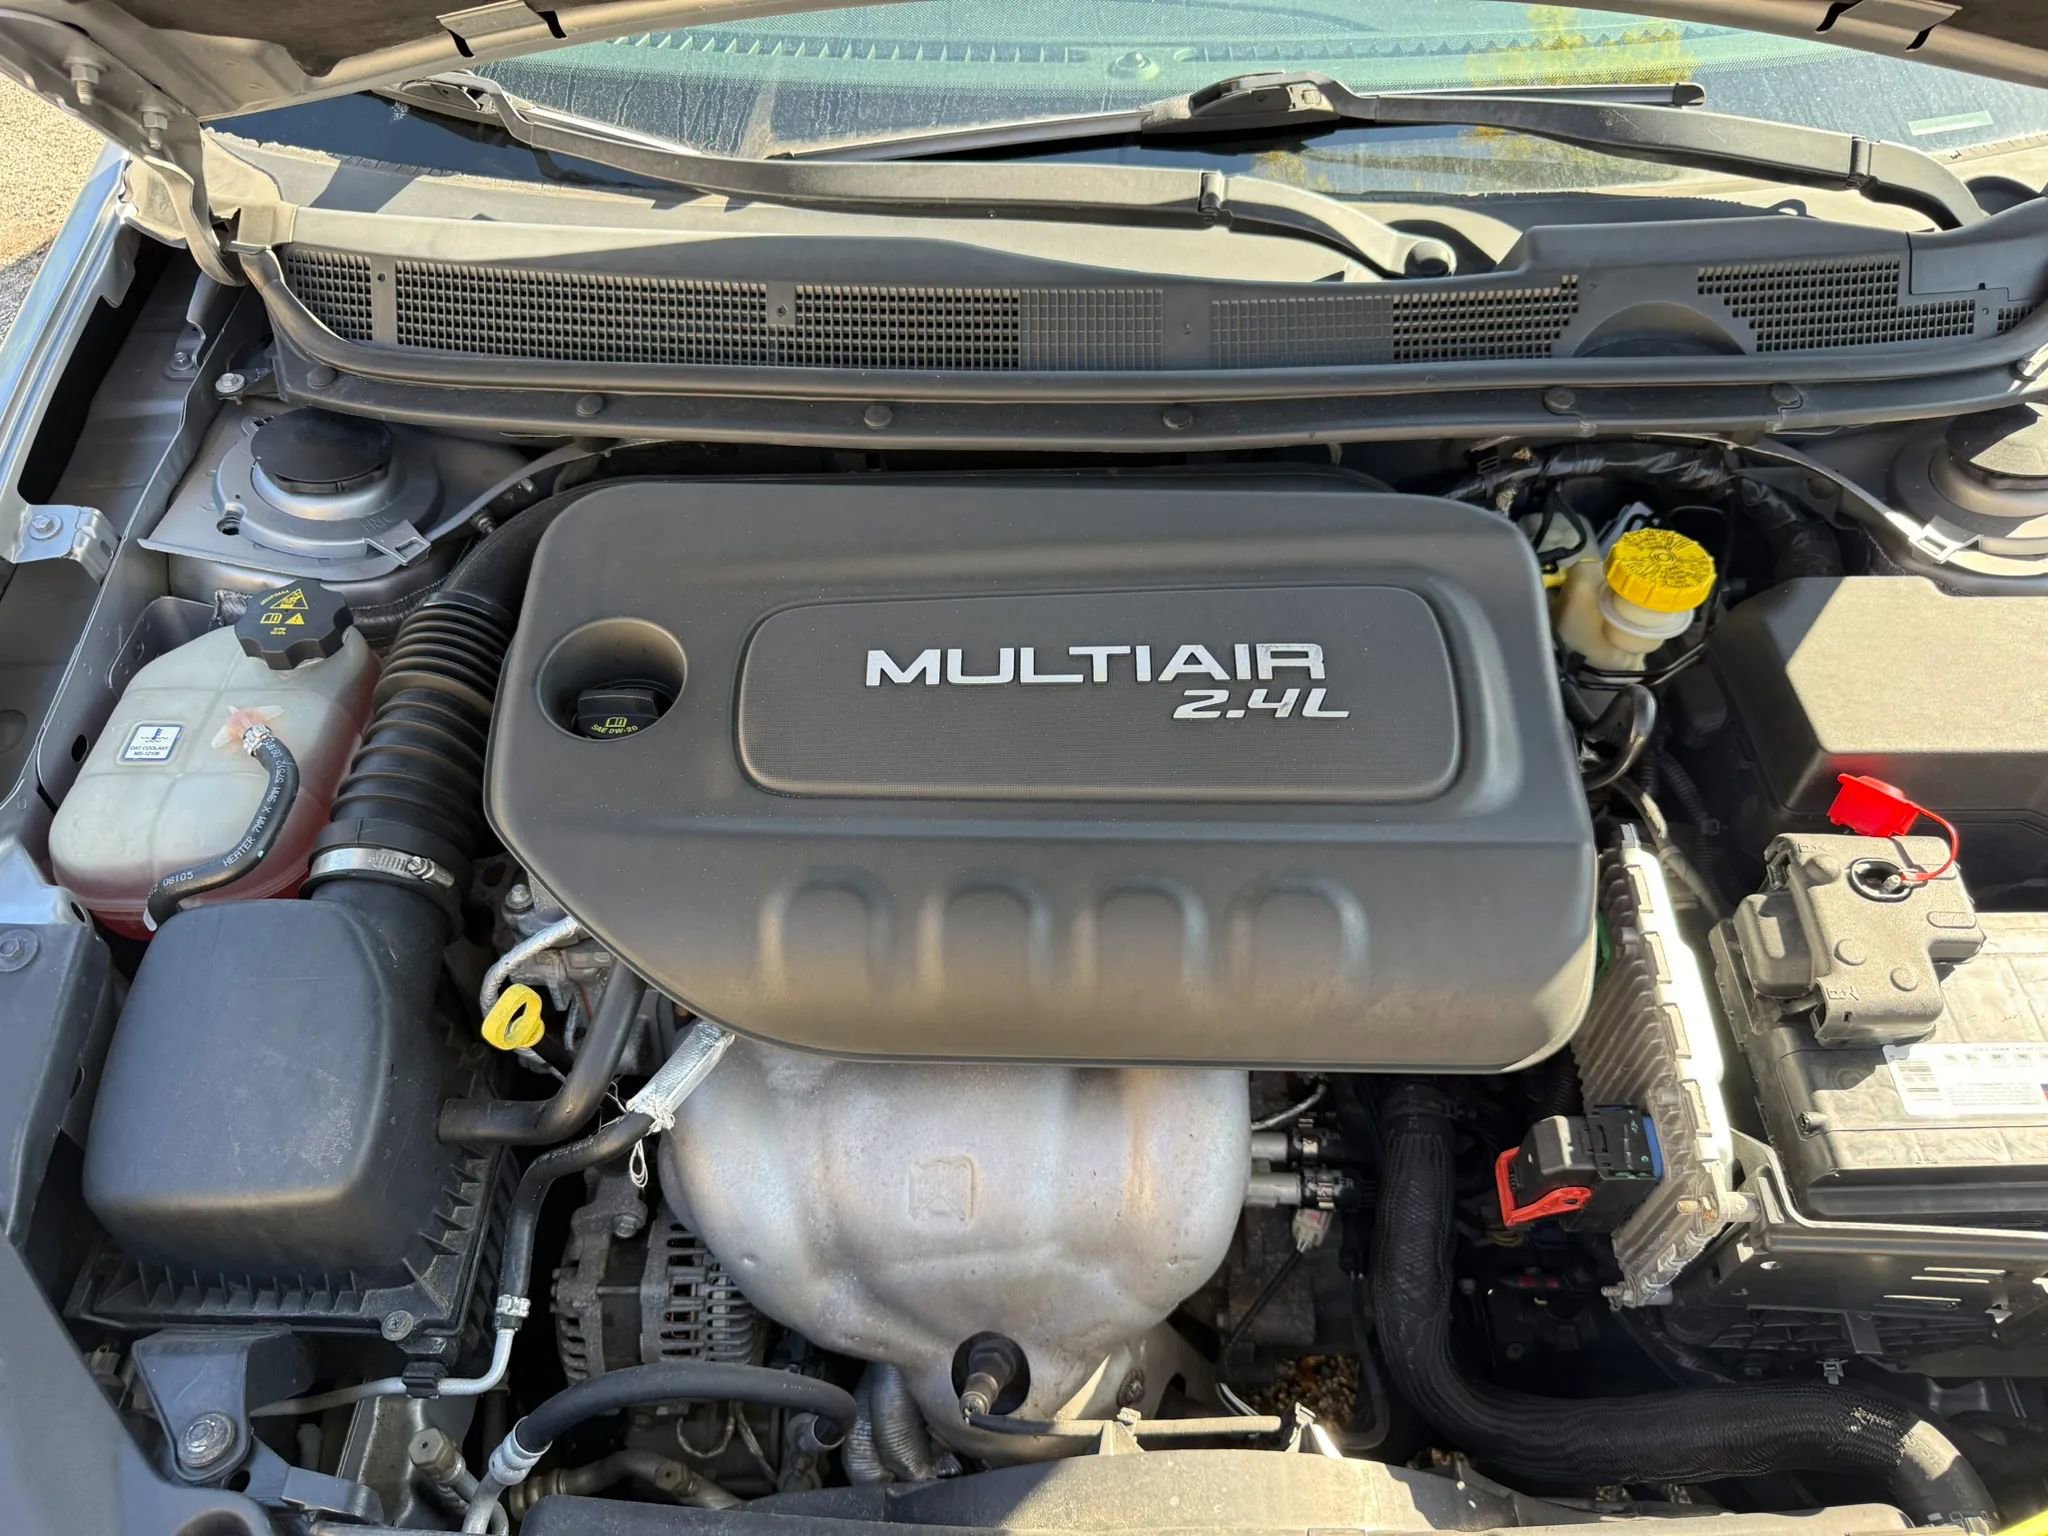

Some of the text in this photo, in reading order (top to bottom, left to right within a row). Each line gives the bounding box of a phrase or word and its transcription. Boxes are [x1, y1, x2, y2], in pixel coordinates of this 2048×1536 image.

[865, 643, 1327, 687] MULTIAIR
[1172, 687, 1351, 719] 2.4L
[591, 724, 639, 734] SAE 0W-20
[222, 835, 256, 867] HEATER
[251, 815, 267, 833] 7MM
[262, 805, 272, 813] X
